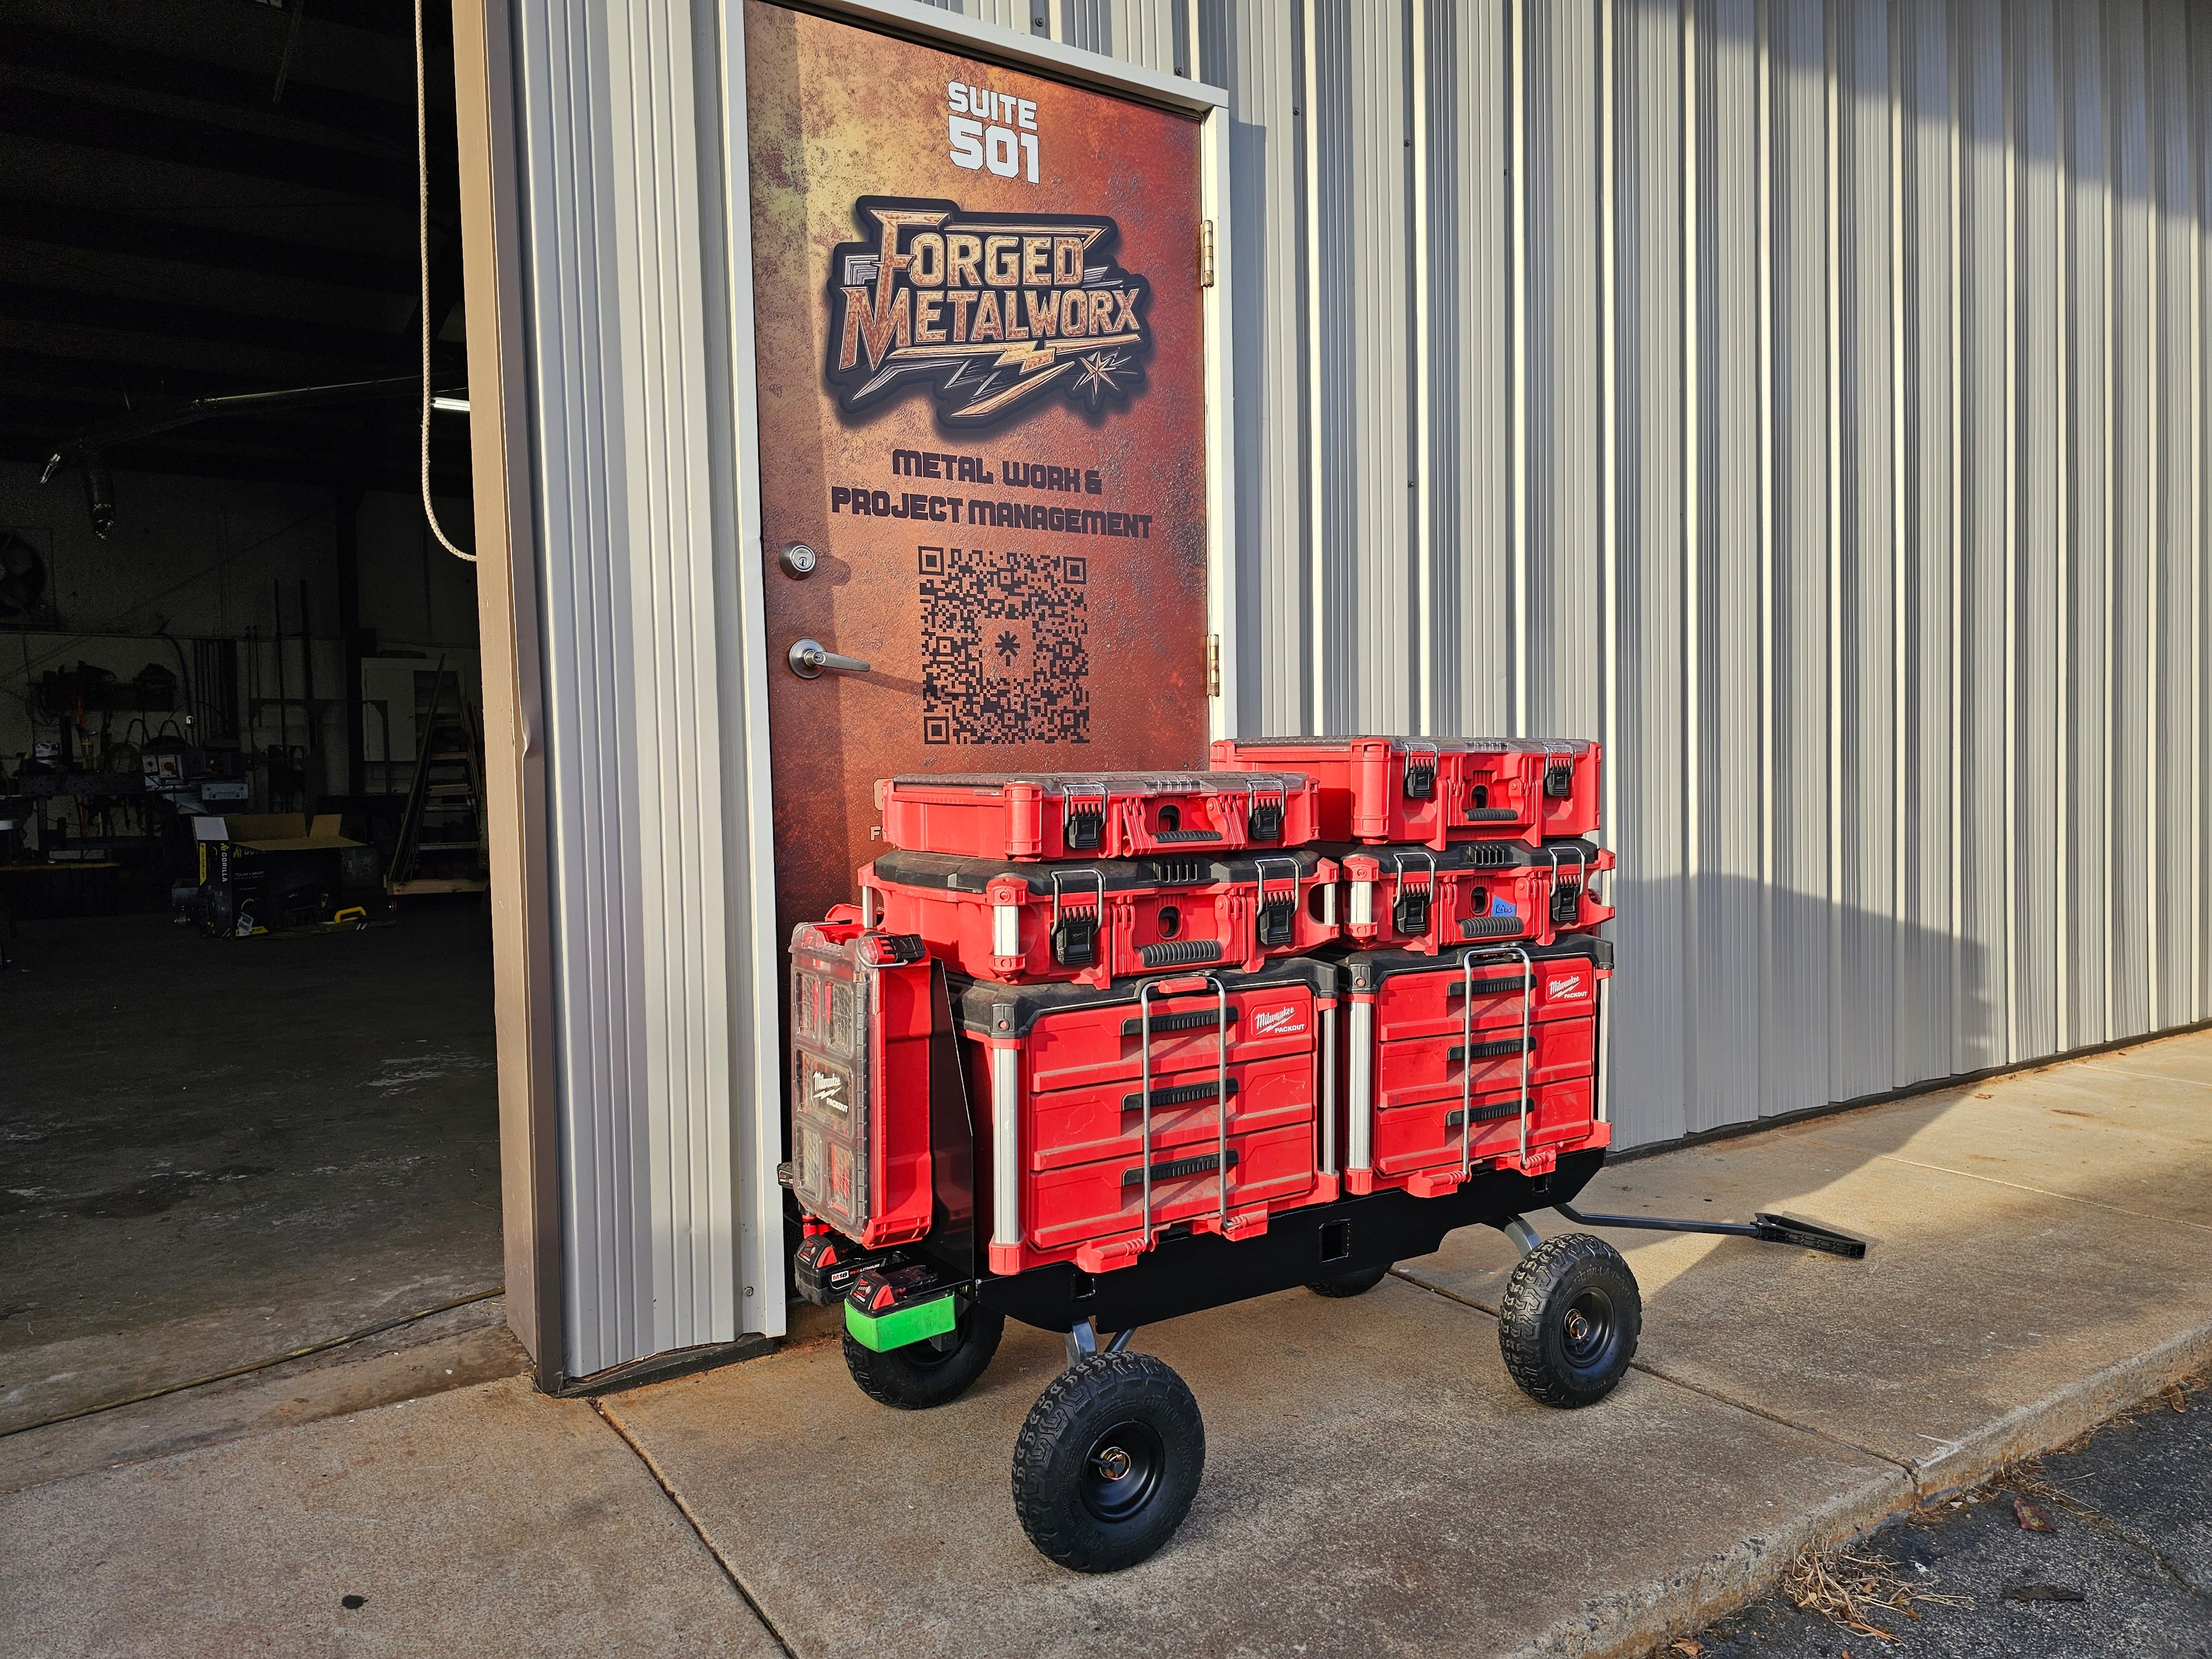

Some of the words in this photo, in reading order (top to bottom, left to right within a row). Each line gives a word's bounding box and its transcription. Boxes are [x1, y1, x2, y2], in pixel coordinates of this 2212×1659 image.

[948, 81, 1038, 131] SUITE
[948, 114, 1040, 184] 501
[870, 209, 1086, 287] FORGED
[839, 287, 1141, 374] METALWORX
[892, 449, 994, 484] METAL
[1002, 460, 1081, 493] WORK
[1084, 469, 1103, 495] &
[831, 486, 963, 524] PROJECT
[968, 499, 1153, 539] MANAGEMENT
[1548, 975, 1580, 995] Milwaukee
[1564, 991, 1588, 999] PACKOUT
[1254, 1006, 1295, 1029] Milwaukee
[1274, 1024, 1305, 1033] PACKOUT
[812, 1071, 841, 1092] Milwaukee
[826, 1097, 849, 1113] PACKOUT
[832, 1272, 848, 1280] M18
